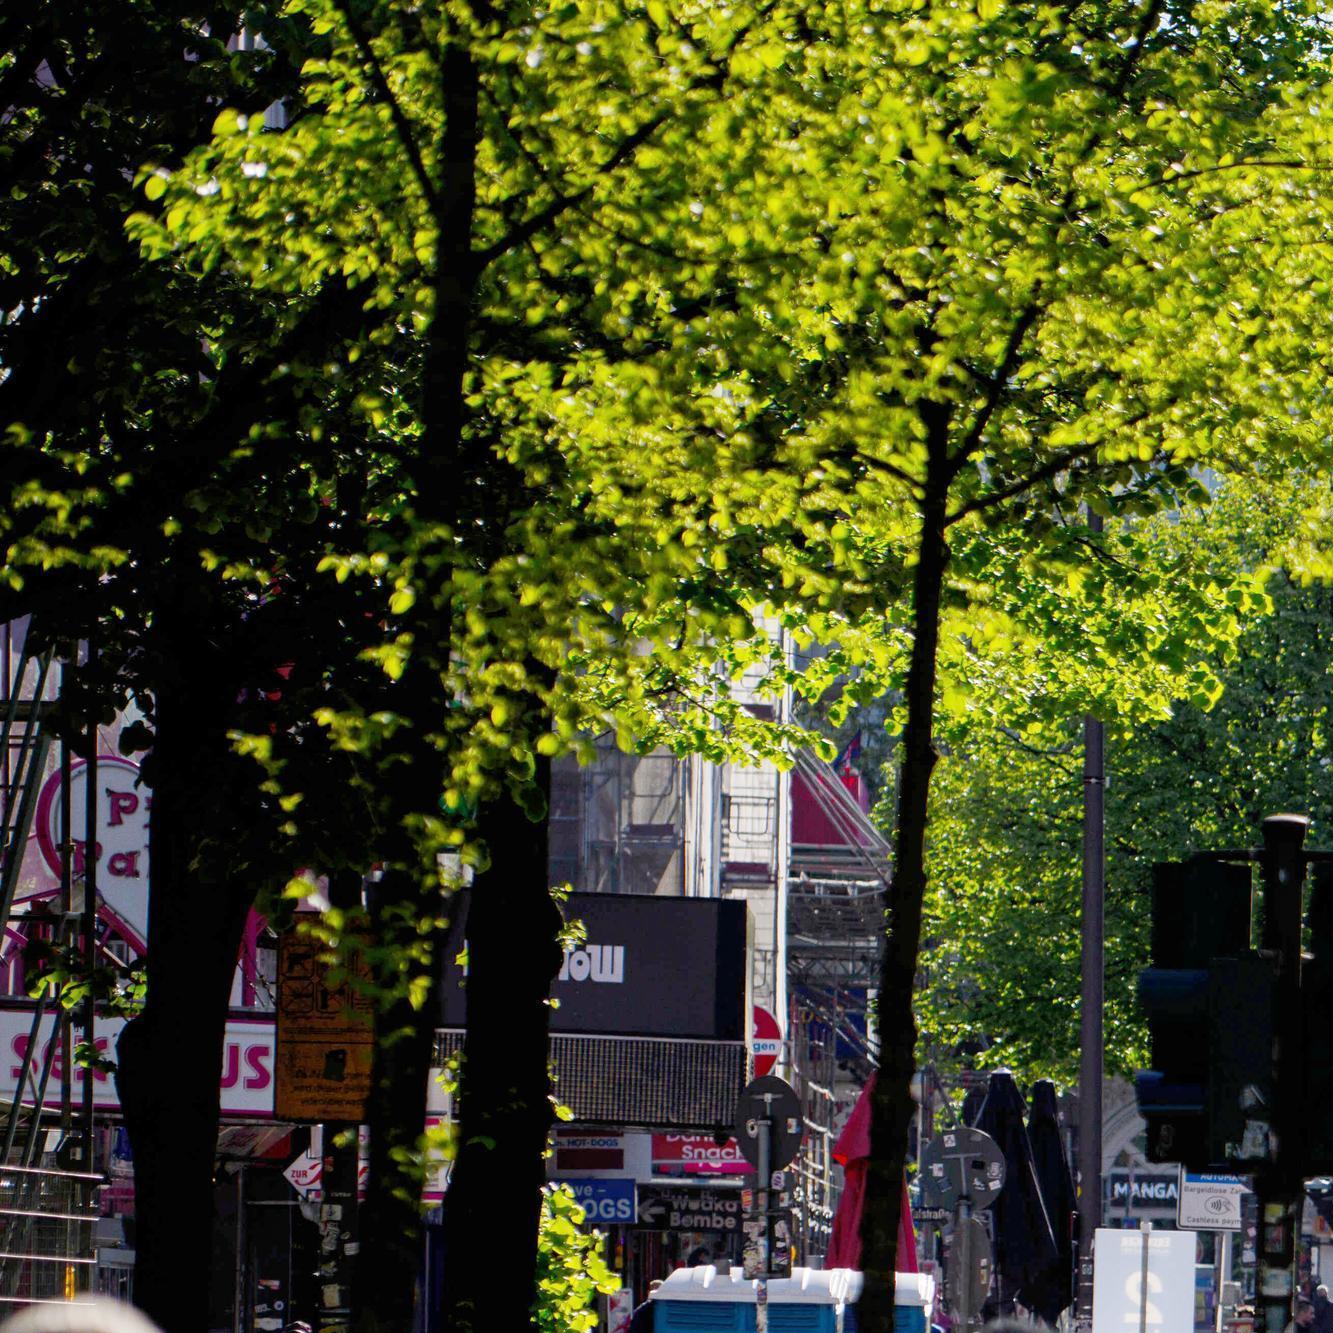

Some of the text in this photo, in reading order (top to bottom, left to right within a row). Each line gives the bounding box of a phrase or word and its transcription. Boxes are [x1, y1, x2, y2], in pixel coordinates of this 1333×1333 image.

[1113, 1182, 1178, 1199] MANGA
[583, 1198, 632, 1219] OGS
[669, 1211, 736, 1230] Bombe
